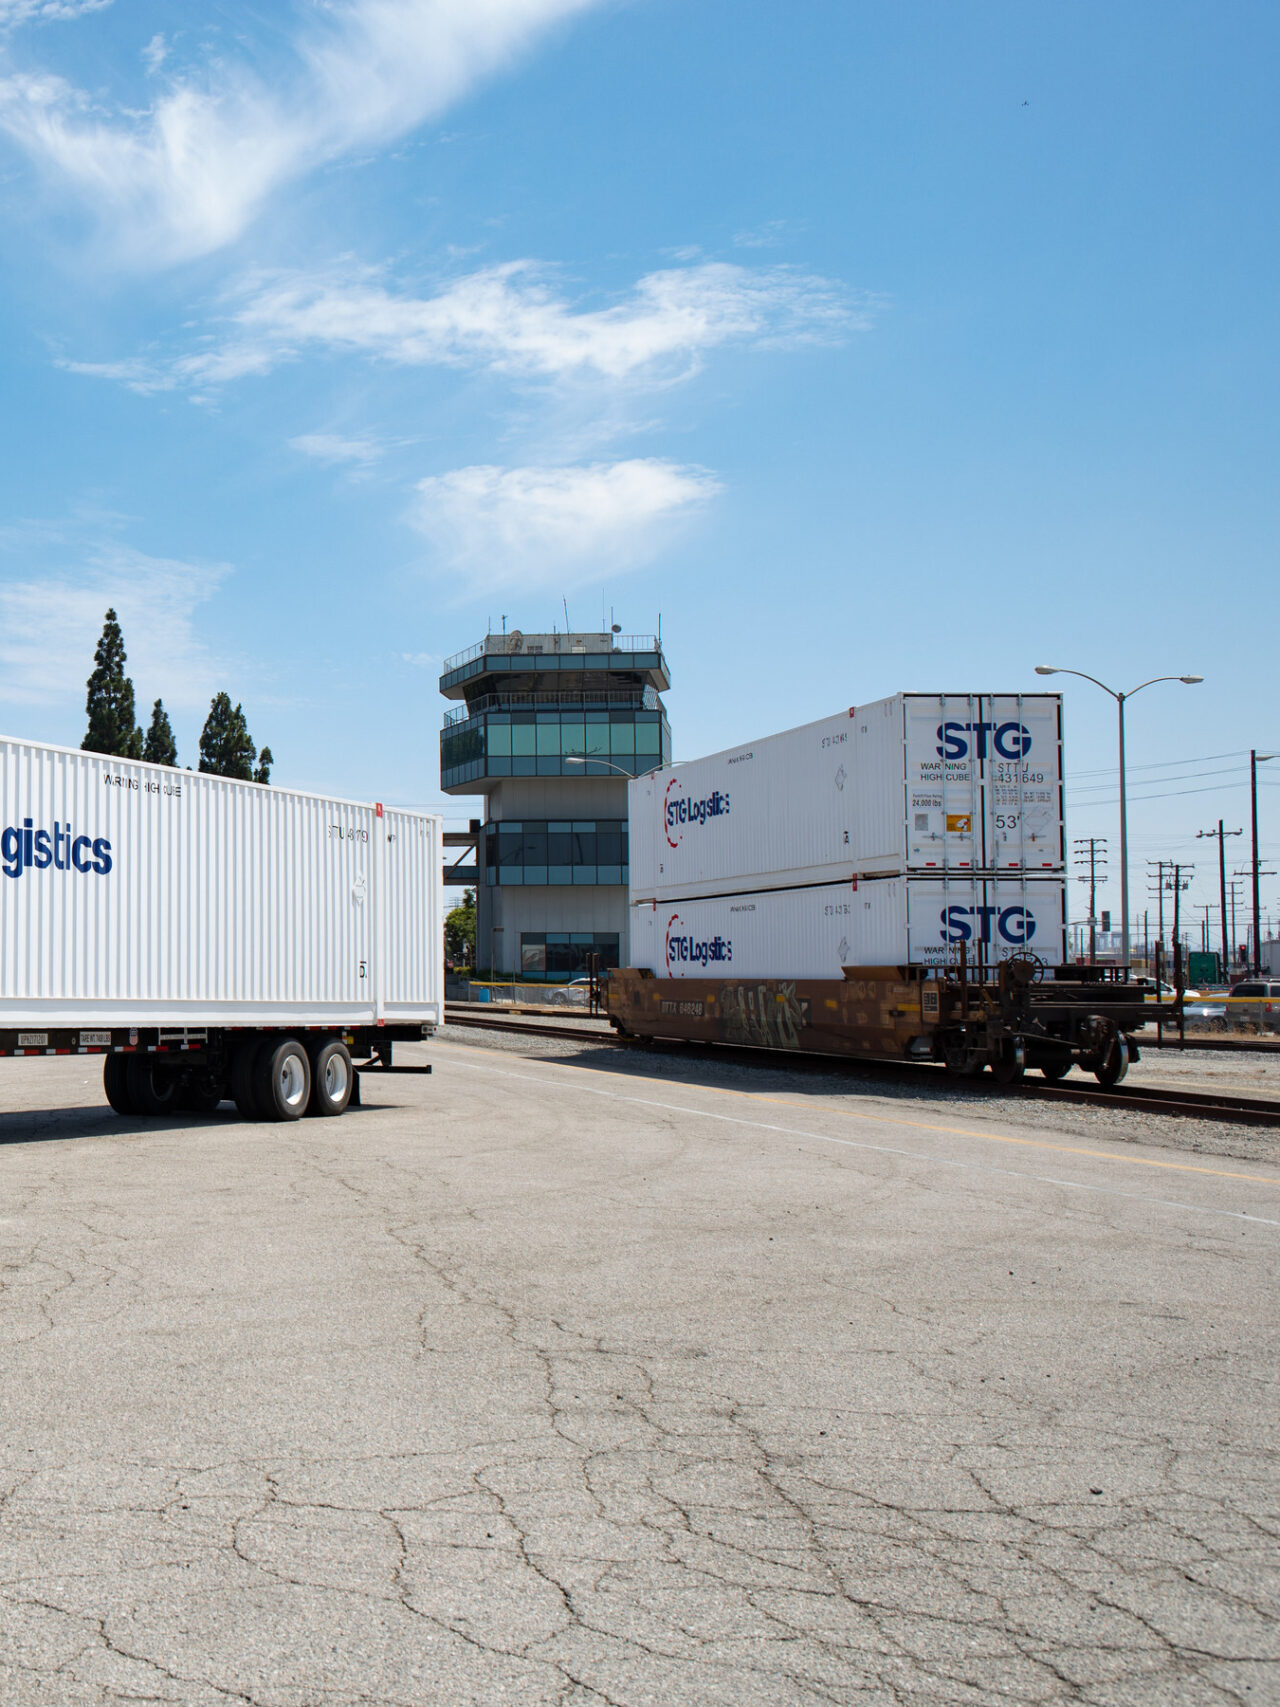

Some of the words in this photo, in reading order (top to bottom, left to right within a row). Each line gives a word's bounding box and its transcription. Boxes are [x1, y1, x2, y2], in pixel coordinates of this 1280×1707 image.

[936, 722, 1032, 760] STG
[920, 763, 967, 771] WARNING
[998, 773, 1044, 784] 431649
[668, 799, 687, 826] STG
[940, 906, 1036, 944] STG
[669, 937, 688, 961] STG
